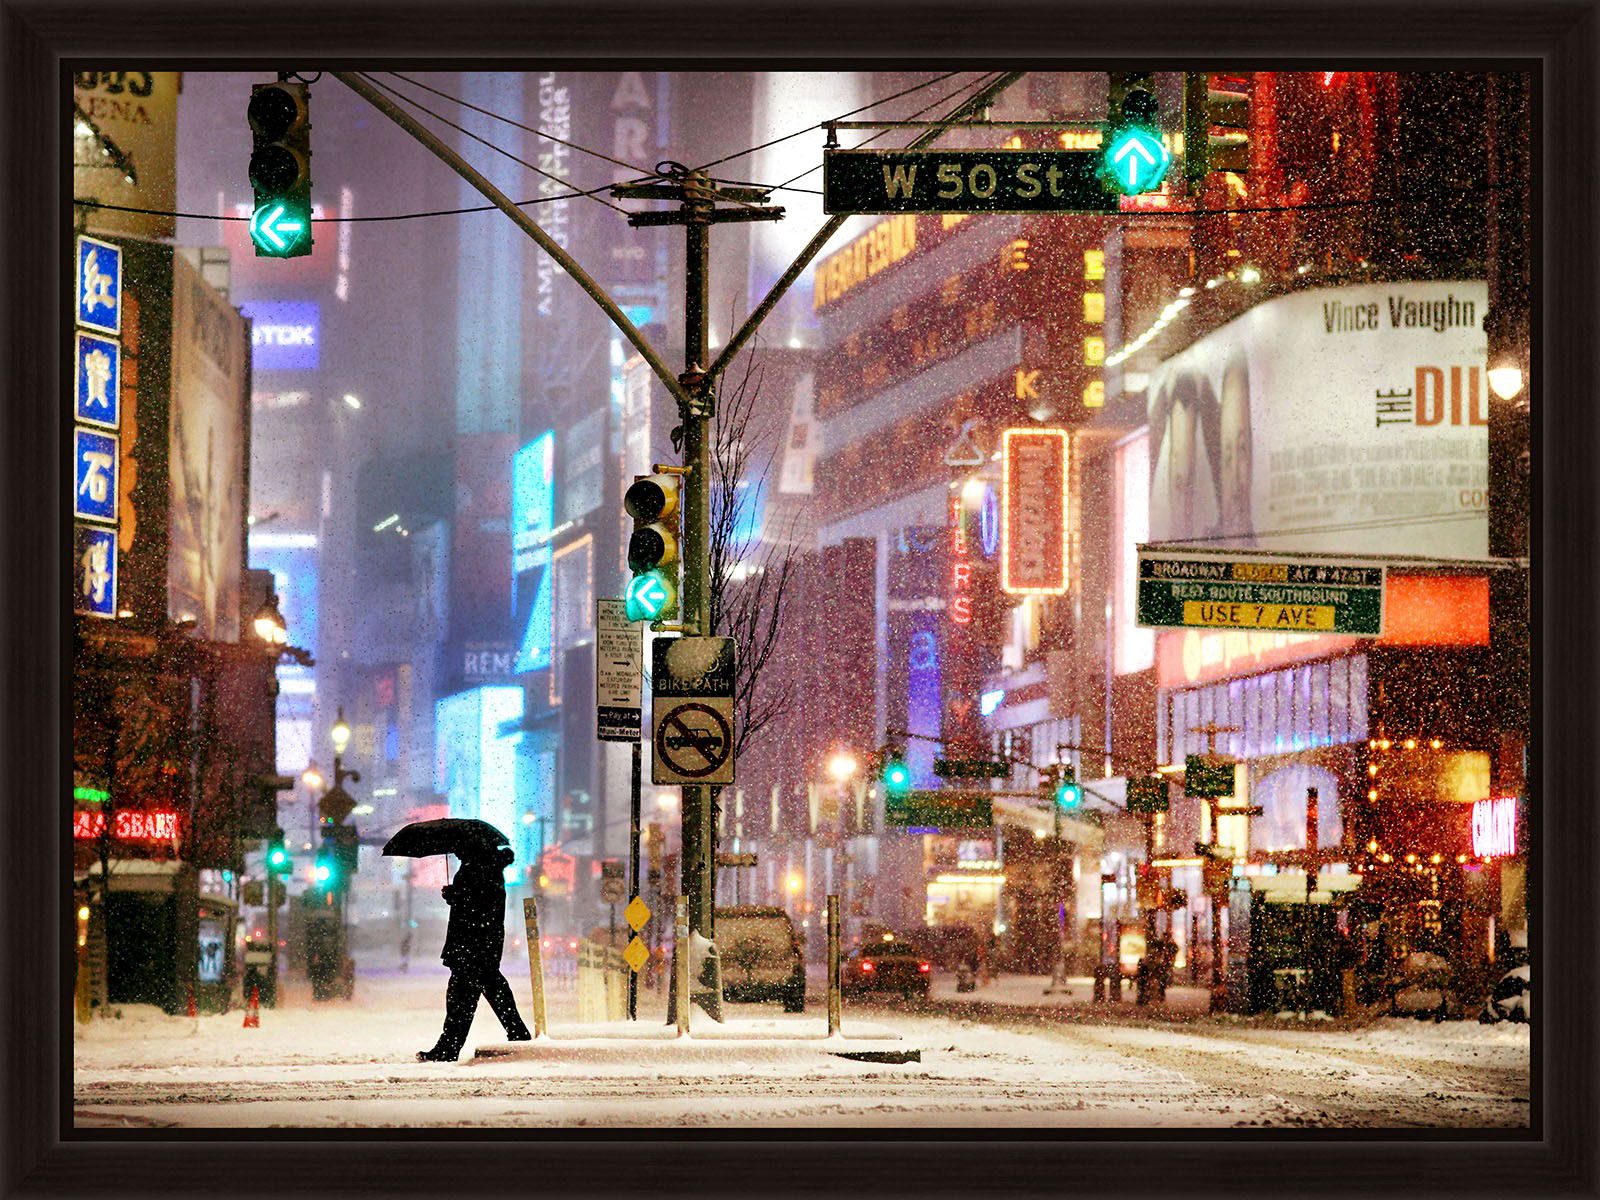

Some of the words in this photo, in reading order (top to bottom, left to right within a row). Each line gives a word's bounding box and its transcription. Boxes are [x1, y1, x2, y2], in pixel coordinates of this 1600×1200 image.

[883, 164, 917, 198] W
[937, 163, 997, 199] 50
[1015, 163, 1063, 198] St
[1322, 299, 1379, 334] Vince
[1388, 294, 1476, 332] Vaughn
[1415, 365, 1488, 427] DIL
[1376, 388, 1412, 428] THE
[1153, 561, 1226, 579] BROADWAY
[1209, 585, 1253, 601] ROUTE
[1259, 588, 1349, 605] SOUTHBOUND
[1201, 604, 1241, 623] USE
[1254, 606, 1264, 623] 7
[1277, 607, 1318, 626] AVE
[659, 679, 690, 691] BIKE
[694, 678, 729, 691] PATH
[609, 712, 621, 721] Pay
